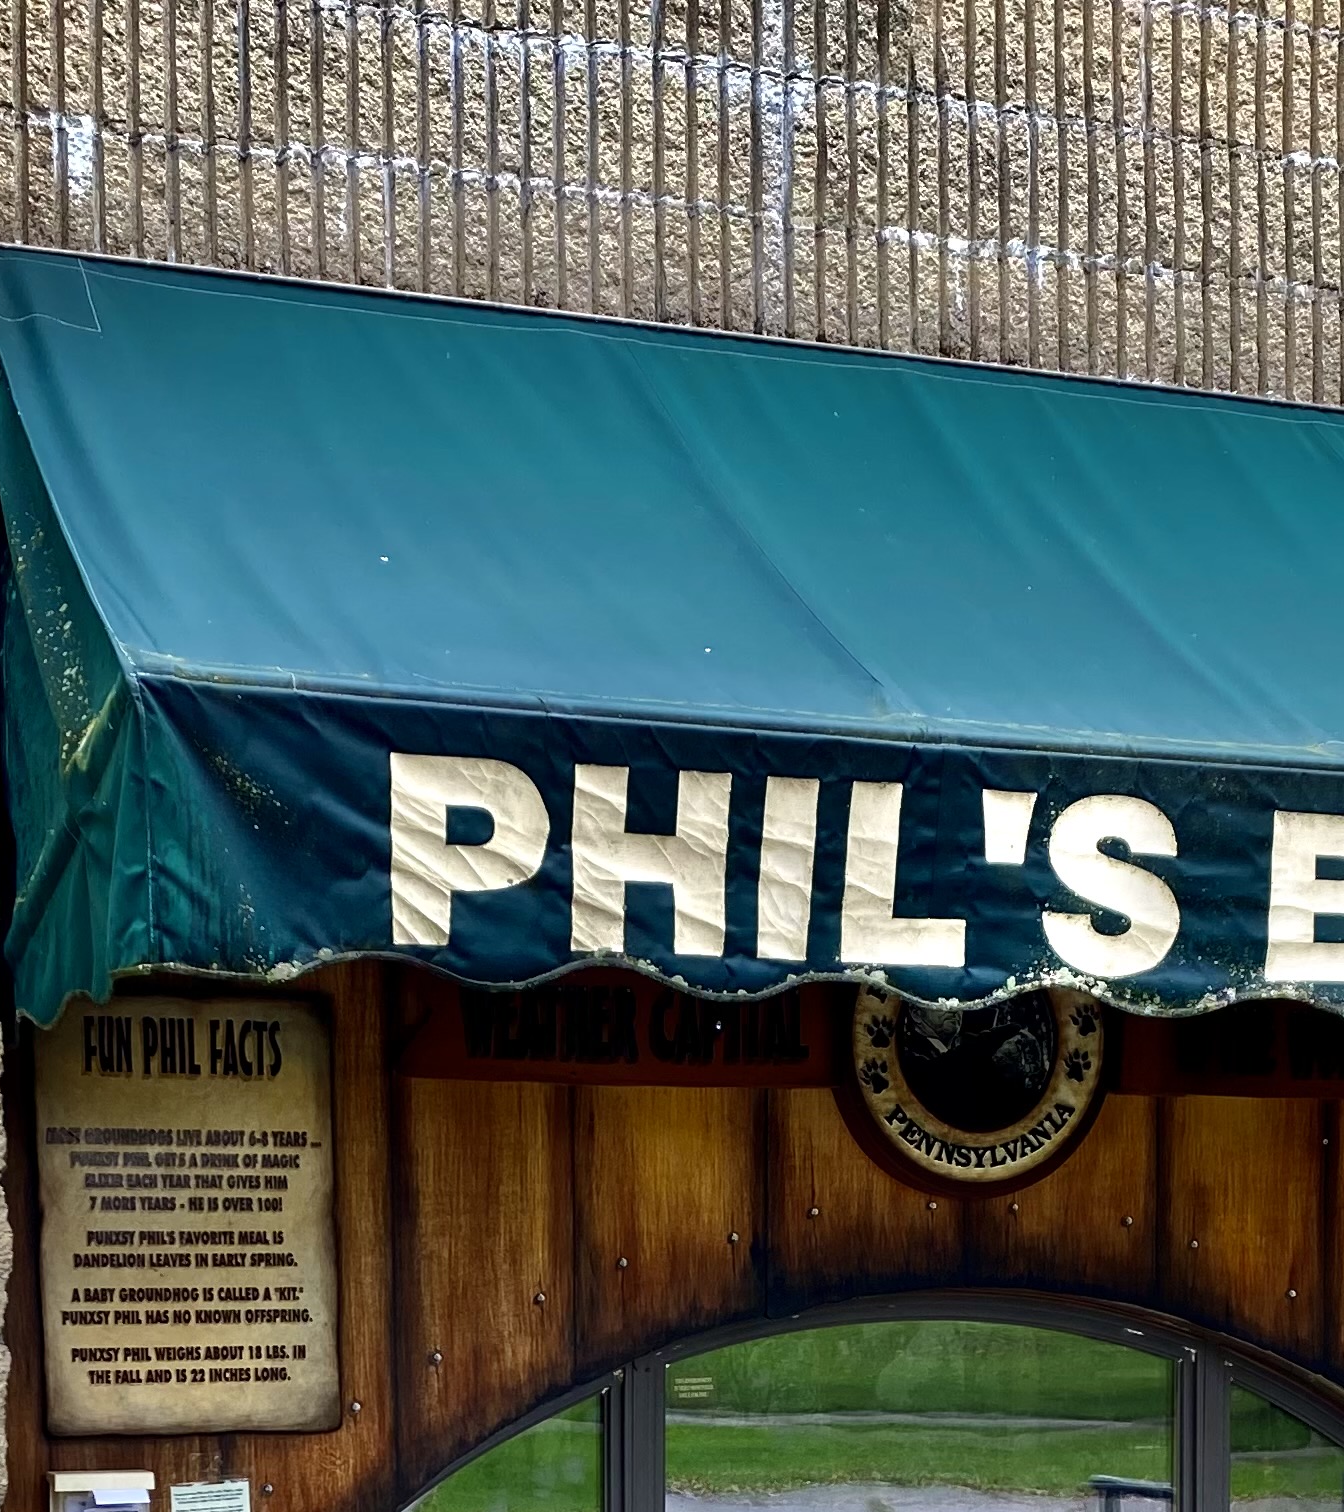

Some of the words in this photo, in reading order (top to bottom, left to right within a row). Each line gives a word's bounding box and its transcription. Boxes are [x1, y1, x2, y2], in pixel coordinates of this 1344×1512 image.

[388, 752, 1180, 984] PHIL'S
[82, 1015, 133, 1073] FUN
[142, 1016, 201, 1075] PHIL
[209, 1019, 282, 1077] FACTS
[176, 1130, 202, 1147] LIVE
[205, 1130, 245, 1147] ABOUT
[249, 1130, 269, 1147] 6-8
[272, 1131, 307, 1148] YEARS
[883, 1102, 1076, 1169] PENNSYLVANIA
[189, 1153, 199, 1169] A
[201, 1153, 239, 1169] DRINK
[242, 1153, 259, 1169] OF
[261, 1153, 300, 1169] MAGIC
[161, 1174, 191, 1189] YEAR
[193, 1174, 223, 1189] THAT
[227, 1174, 261, 1190] GIVES
[264, 1175, 288, 1190] HIM
[100, 1196, 137, 1211] MORE
[139, 1196, 177, 1211] YEARS
[188, 1196, 204, 1212] HE
[208, 1197, 219, 1212] IS
[223, 1197, 253, 1212] OVER
[257, 1196, 283, 1212] 100!
[86, 1231, 136, 1247] PUNXSY
[139, 1230, 176, 1246] PHIL'S
[179, 1230, 235, 1246] FAVORITE
[238, 1230, 270, 1246] MEAL
[273, 1230, 284, 1245] IS
[73, 1253, 146, 1268] DANDELION
[149, 1253, 192, 1268] LEAVES
[195, 1253, 209, 1267] IN
[212, 1253, 247, 1268] EARLY
[250, 1253, 298, 1267] SPRING.
[71, 1288, 81, 1303] A
[84, 1288, 116, 1303] BABY
[118, 1288, 199, 1302] GROUNDHOG
[203, 1287, 214, 1302] IS
[217, 1287, 260, 1301] CALLED
[262, 1287, 272, 1301] A
[61, 1310, 110, 1325] PUNXSY
[114, 1310, 142, 1325] PHIL
[145, 1310, 170, 1325] HAS
[173, 1310, 192, 1324] NO
[195, 1309, 241, 1324] KNOWN
[244, 1309, 313, 1324] OFFSPRING.
[71, 1348, 120, 1363] PUNXSY
[123, 1347, 152, 1362] PHIL
[155, 1346, 201, 1362] WEIGHS
[205, 1345, 244, 1361] ABOUT
[248, 1345, 262, 1360] 18
[265, 1345, 290, 1360] LBS.
[293, 1345, 306, 1360] IN
[88, 1370, 111, 1385] THE
[115, 1370, 143, 1384] FALL
[145, 1369, 172, 1384] AND
[176, 1369, 187, 1383] IS
[190, 1368, 205, 1382] 22
[209, 1367, 251, 1382] INCHES
[254, 1367, 291, 1382] LONG.
